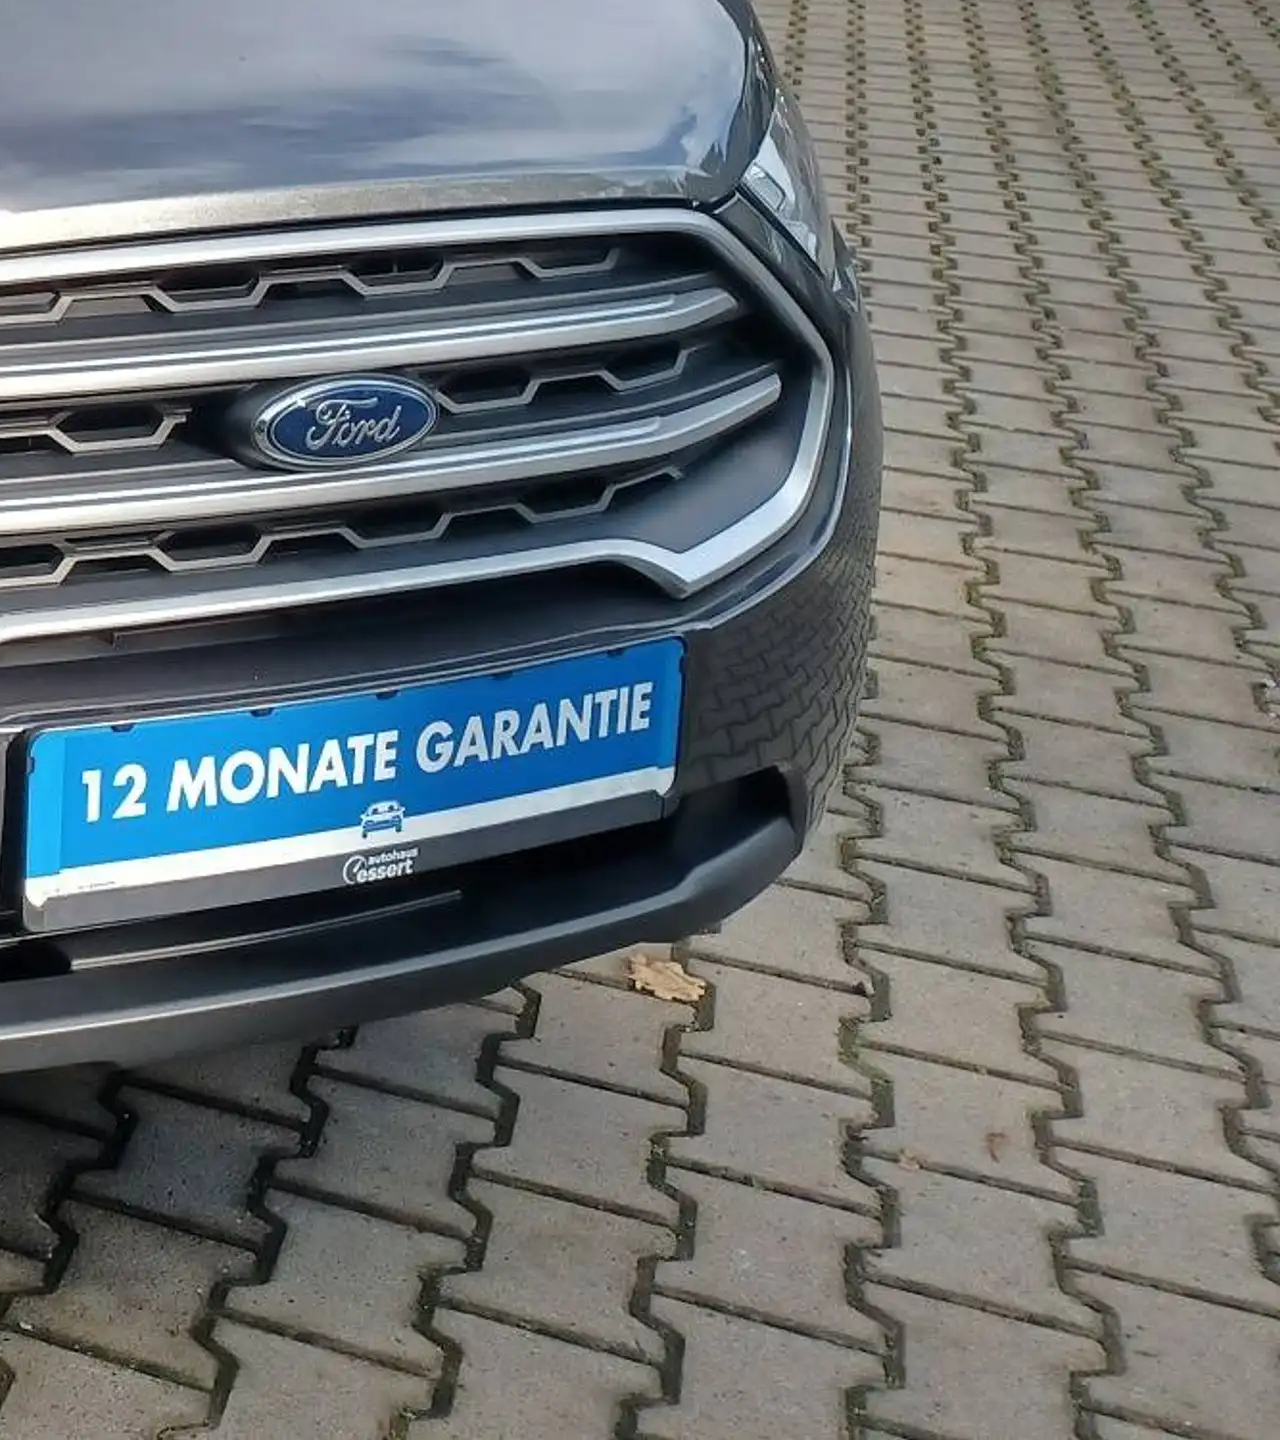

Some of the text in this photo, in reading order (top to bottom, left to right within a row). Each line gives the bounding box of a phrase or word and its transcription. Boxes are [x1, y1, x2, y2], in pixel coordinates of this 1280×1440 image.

[305, 397, 402, 451] Ford
[80, 682, 654, 822] 12 MONATE GARANTIE
[356, 859, 414, 883] essert
[368, 847, 418, 865] autohaus
